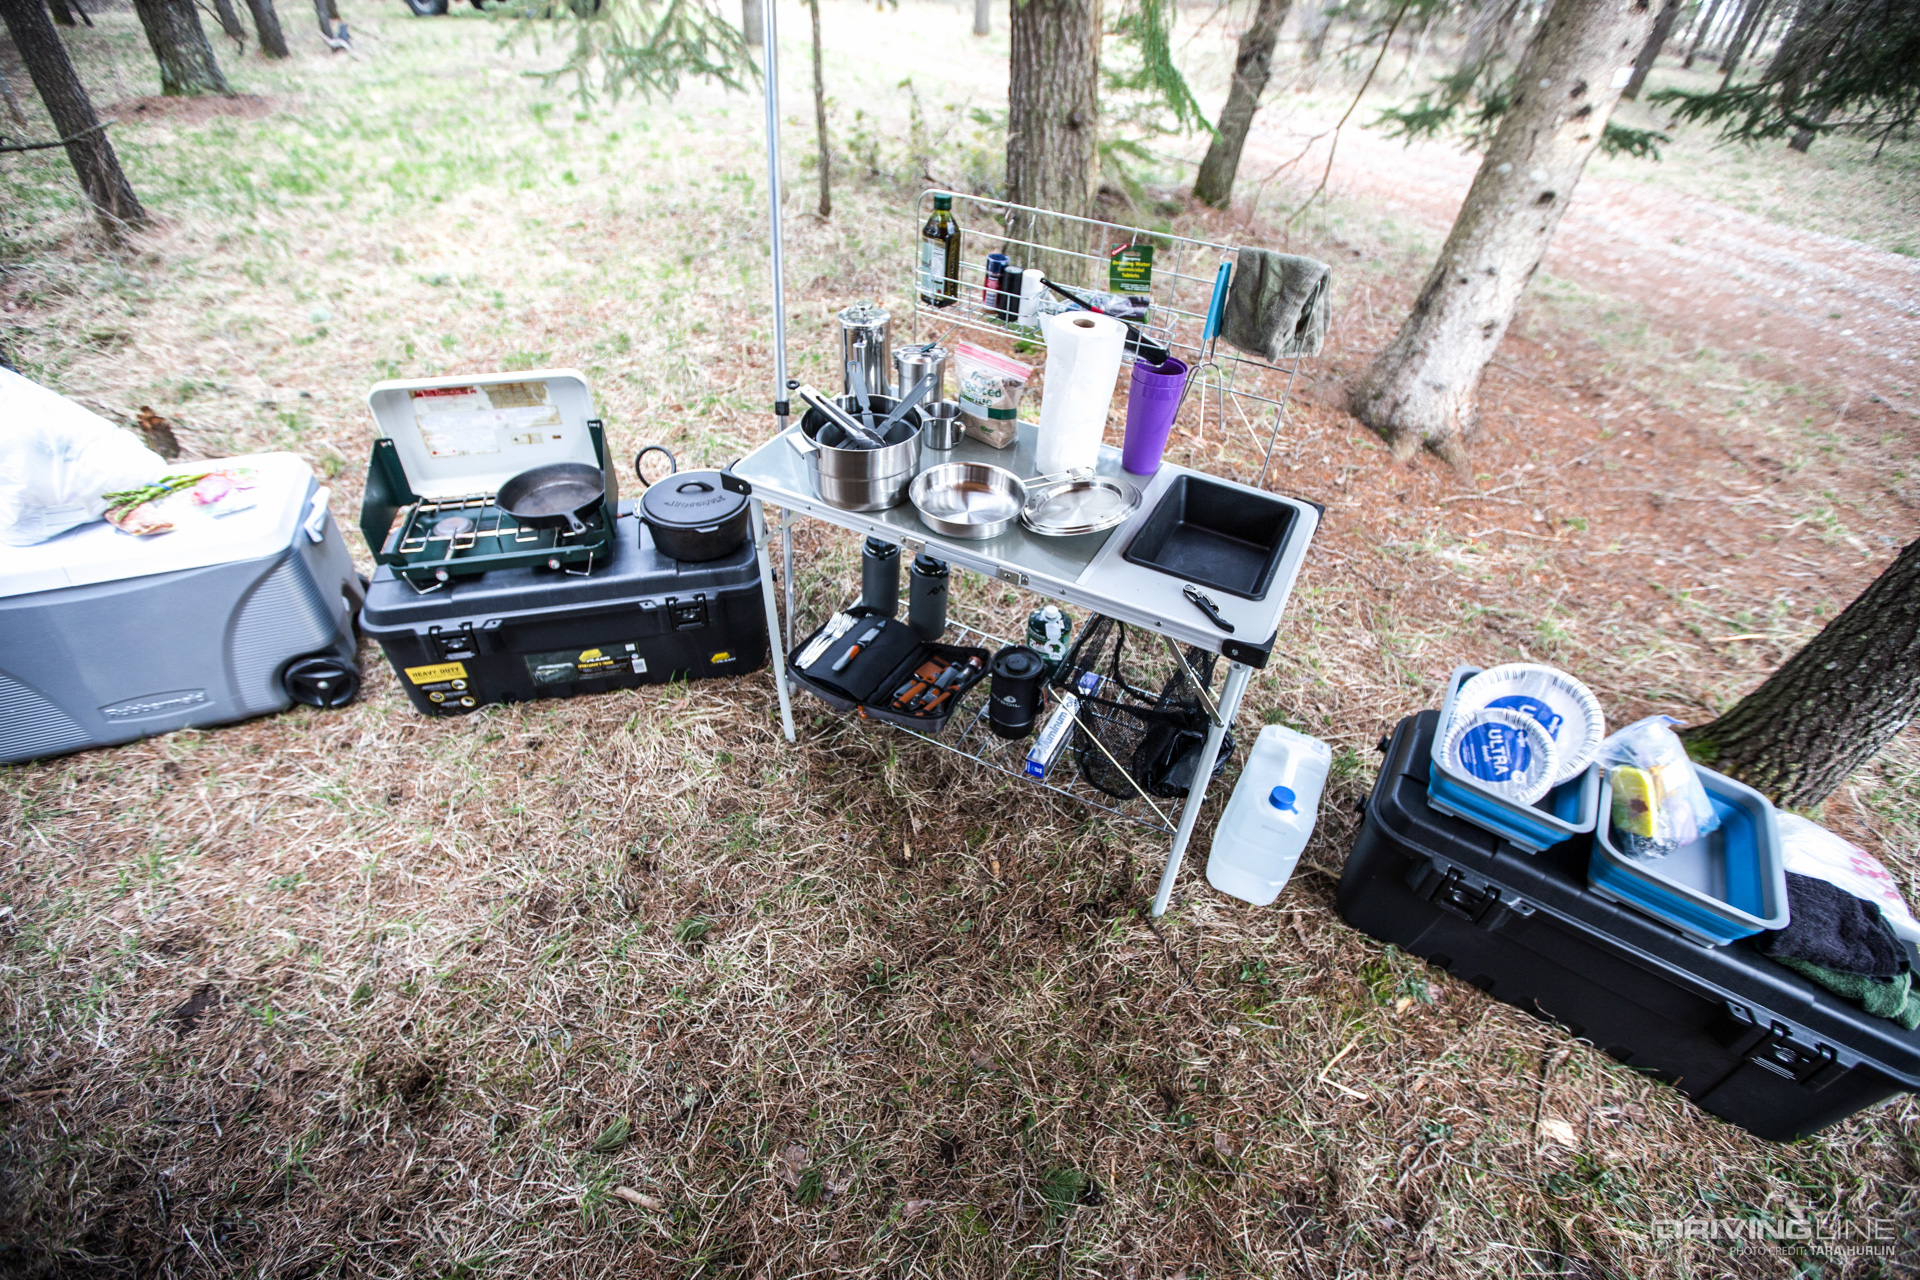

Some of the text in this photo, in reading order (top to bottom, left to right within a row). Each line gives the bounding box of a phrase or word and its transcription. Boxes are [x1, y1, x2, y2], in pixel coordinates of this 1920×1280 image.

[411, 669, 437, 677] HEAVY
[1039, 711, 1068, 753] Aluminum
[1488, 728, 1510, 776] ULTRA
